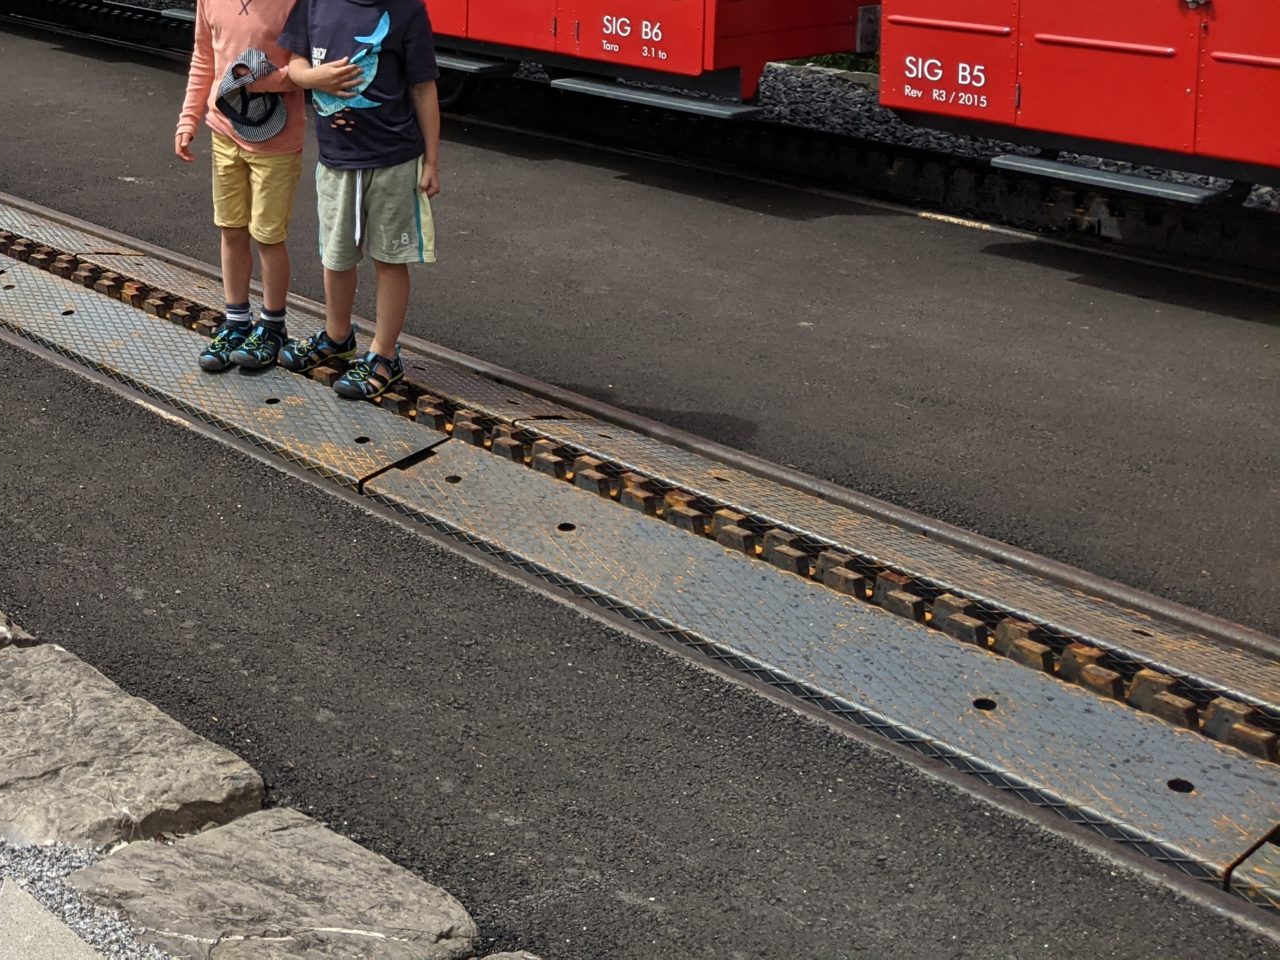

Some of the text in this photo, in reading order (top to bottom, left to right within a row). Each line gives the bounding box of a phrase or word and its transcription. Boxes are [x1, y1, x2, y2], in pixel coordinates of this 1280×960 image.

[602, 15, 663, 42] SIG B6
[601, 39, 668, 60] Tara 3.1 to
[904, 55, 986, 87] SIG B5
[904, 84, 923, 98] Rev
[932, 88, 947, 102] R3
[958, 92, 988, 108] 2015
